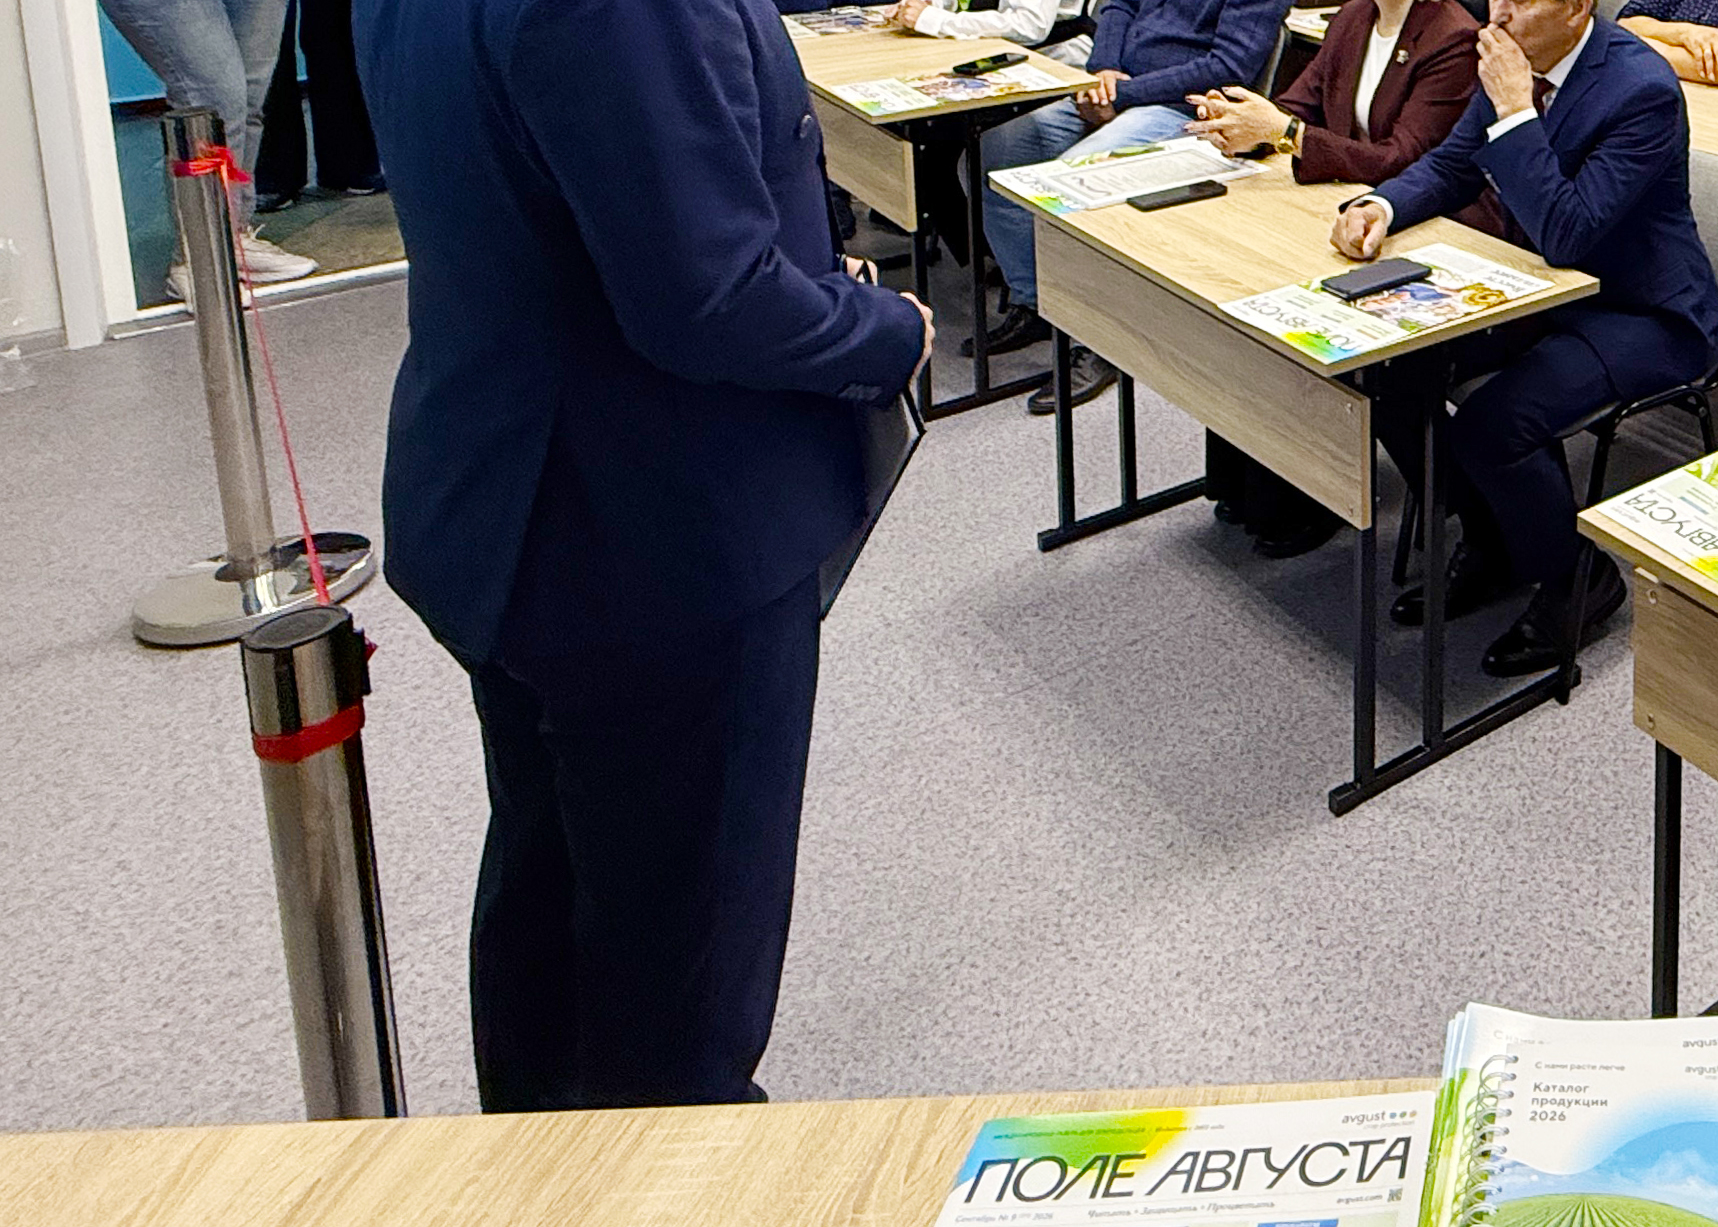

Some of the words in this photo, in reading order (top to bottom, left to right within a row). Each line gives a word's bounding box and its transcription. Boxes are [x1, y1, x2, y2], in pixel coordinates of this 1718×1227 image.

[1535, 1061, 1543, 1069] С
[1599, 1064, 1626, 1072] легче
[1533, 1082, 1590, 1093] Каталог
[1531, 1097, 1609, 1109] продукции
[1342, 1111, 1385, 1125] avgust
[1529, 1110, 1567, 1122] 2026
[965, 1154, 1145, 1202] ПОЛЕ
[1148, 1137, 1410, 1194] АВГУСТА
